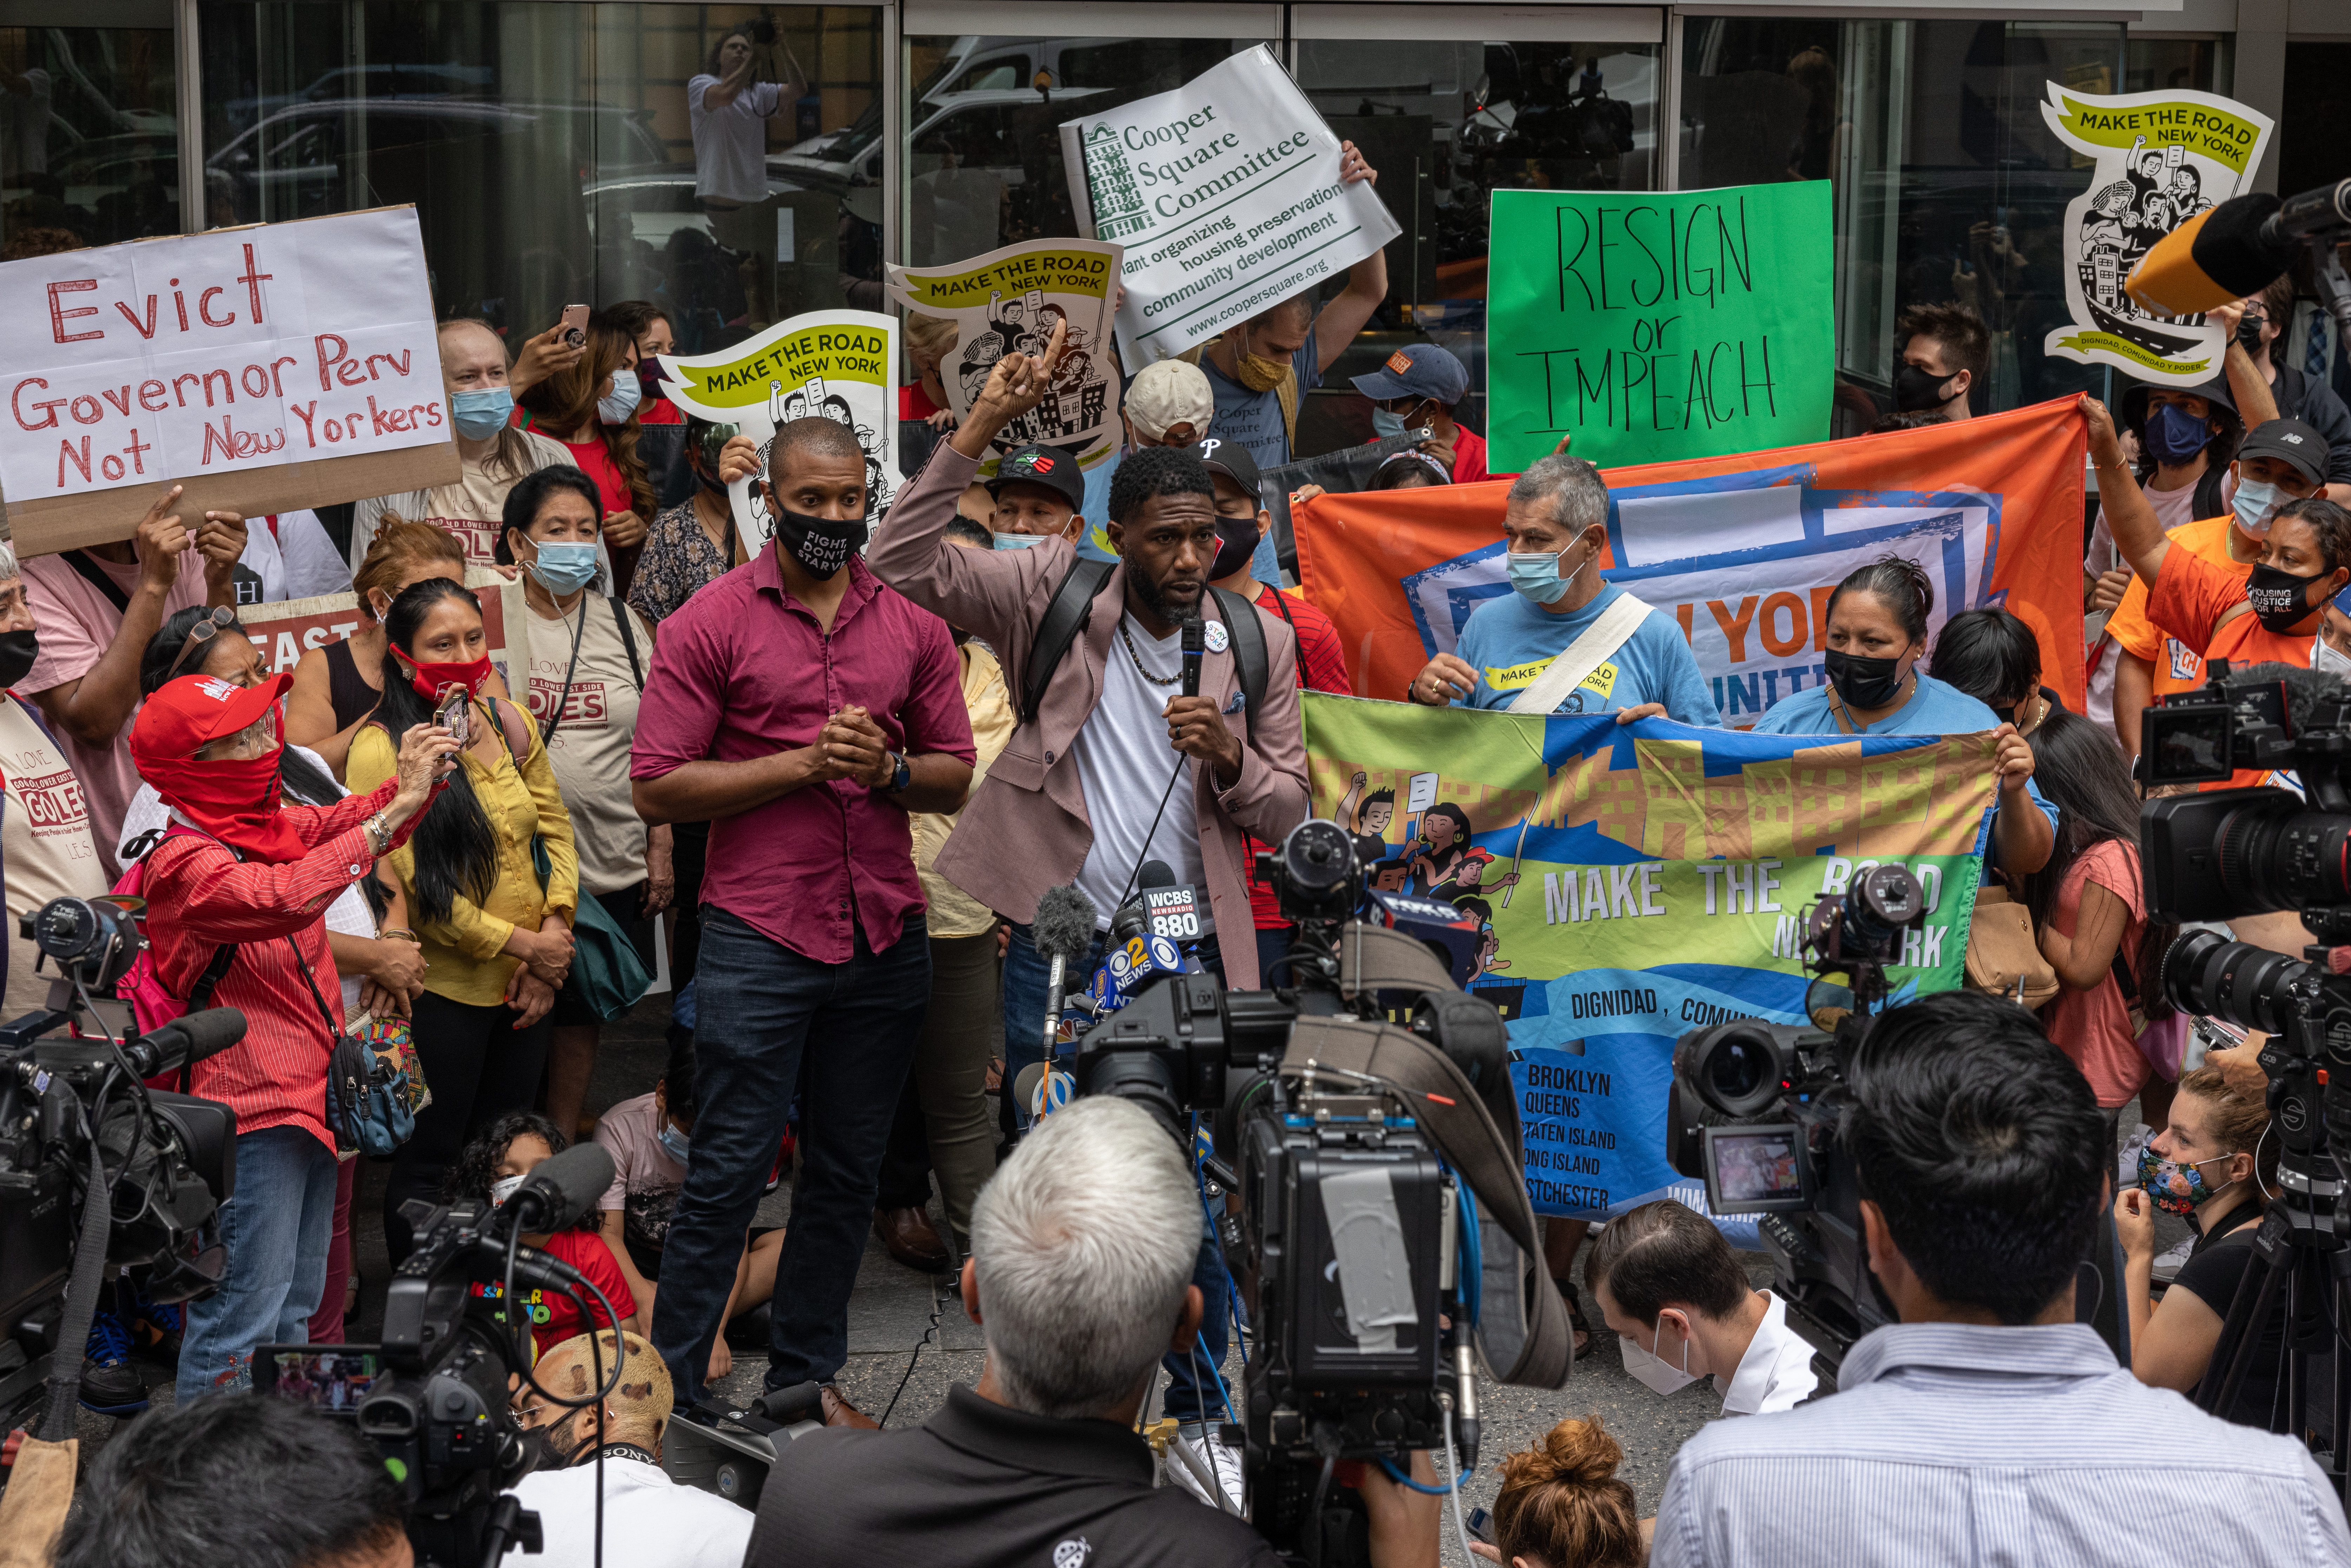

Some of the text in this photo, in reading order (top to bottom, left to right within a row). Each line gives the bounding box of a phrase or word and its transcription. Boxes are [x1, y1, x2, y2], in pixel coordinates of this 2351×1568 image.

[1124, 103, 1217, 152] Cooper
[2080, 109, 2252, 145] MAKE THE ROAD
[1138, 132, 1240, 187] Square
[2157, 129, 2244, 163] NEW YORK
[1155, 131, 1310, 217] Committee
[1151, 215, 1236, 263] organizing
[1180, 183, 1344, 272] housing preservation
[1143, 211, 1338, 318] community development
[1557, 196, 1752, 311] RESIGN
[931, 257, 1105, 296] MAKE THE ROAD
[1011, 274, 1102, 292] NEW YORK
[47, 243, 272, 343] Evict
[1186, 259, 1329, 337] www.coopersquare.org
[1633, 316, 1682, 352] or
[707, 334, 882, 393] MAKE THE ROAD
[2081, 338, 2120, 349] DIGNIDAD,
[2122, 345, 2166, 369] COMUNIDAD
[12, 334, 411, 431] Governor Perv
[789, 356, 881, 381] NEW YORK
[1516, 335, 1776, 433] IMPEACH
[1219, 407, 1261, 421] Cooper
[57, 395, 442, 488] Not New Yorkers
[1213, 423, 1260, 437] Square
[1081, 450, 1105, 463] PODER
[1200, 439, 1221, 458] P
[453, 500, 496, 514] LOVE
[463, 521, 487, 529] LOWER
[807, 531, 847, 549] FIGHT,
[798, 549, 846, 572] STARVE
[2253, 587, 2291, 597] HOUSING
[2254, 596, 2291, 606] JUSTICE
[2254, 603, 2269, 612] FOR
[1205, 630, 1223, 649] WOKE
[1209, 624, 1227, 641] STAY
[1501, 667, 1537, 683] MAKE
[1591, 667, 1612, 679] AD
[219, 689, 231, 702] New
[16, 750, 52, 769] LOVE
[36, 777, 57, 789] LOWER
[56, 773, 69, 783] EAST
[26, 785, 87, 822] GOLES
[1148, 890, 1192, 908] WCBS
[1544, 864, 1666, 926] MAKE
[1697, 861, 1783, 915] THE
[1151, 905, 1193, 915] NEWSRADIO
[1152, 913, 1199, 938] 880
[1127, 936, 1148, 968] 2
[1899, 925, 1949, 968] RK
[1051, 953, 1060, 983] REUTERS
[1116, 960, 1152, 991] NEWS
[1571, 988, 1657, 1020] DIGNIDAD
[1528, 1064, 1610, 1096] BROKLYN
[1525, 1091, 1580, 1119] QUEENS
[1569, 1127, 1616, 1150] ISLAND
[1524, 1148, 1600, 1175] ONG ISLAND
[1525, 1178, 1609, 1211] STCHESTER
[603, 1448, 655, 1465] SONY
